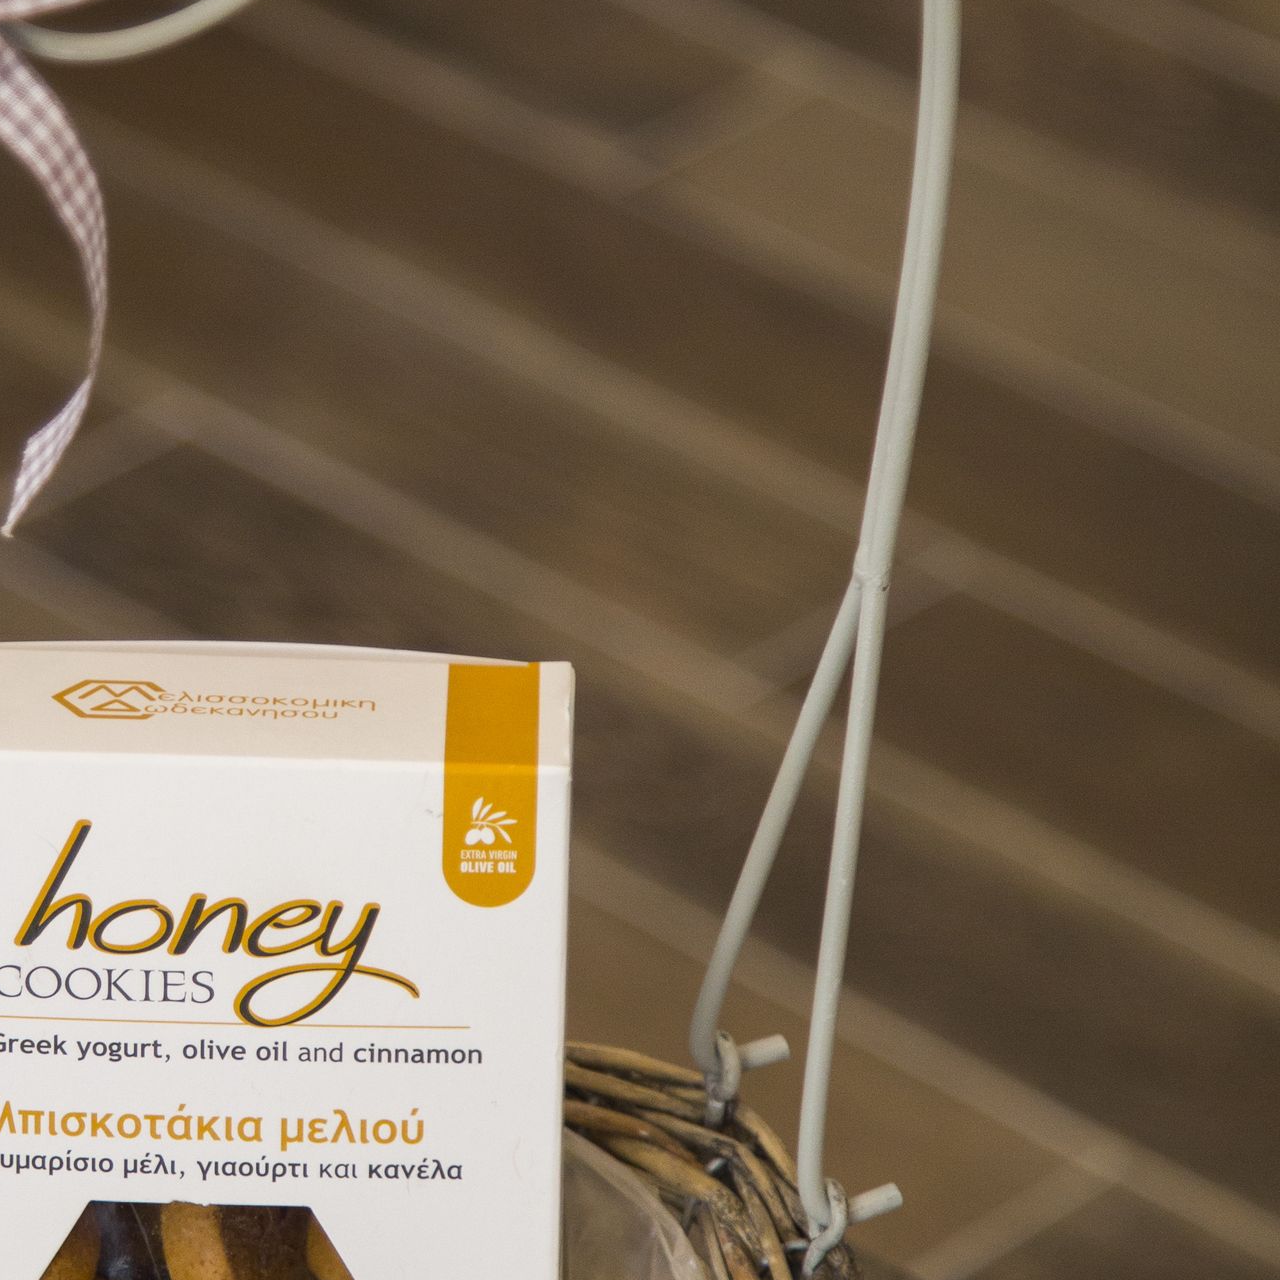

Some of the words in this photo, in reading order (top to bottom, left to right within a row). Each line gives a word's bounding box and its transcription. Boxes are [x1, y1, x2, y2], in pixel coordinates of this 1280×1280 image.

[460, 849, 488, 860] EXTRA
[489, 850, 518, 861] VIRGIN
[460, 861, 495, 874] OLIVE
[497, 861, 517, 874] OIL
[13, 818, 421, 1027] honey
[76, 1036, 172, 1064] yogurt,
[182, 1038, 247, 1062] olive
[255, 1040, 288, 1062] oil
[297, 1041, 344, 1064] and
[353, 1041, 484, 1065] cinnamon
[280, 1106, 426, 1152] μελιού
[123, 1151, 185, 1180] μέλι,
[196, 1149, 309, 1183] γιαούρτι
[319, 1162, 358, 1180] και
[368, 1157, 463, 1181] κανέλα
